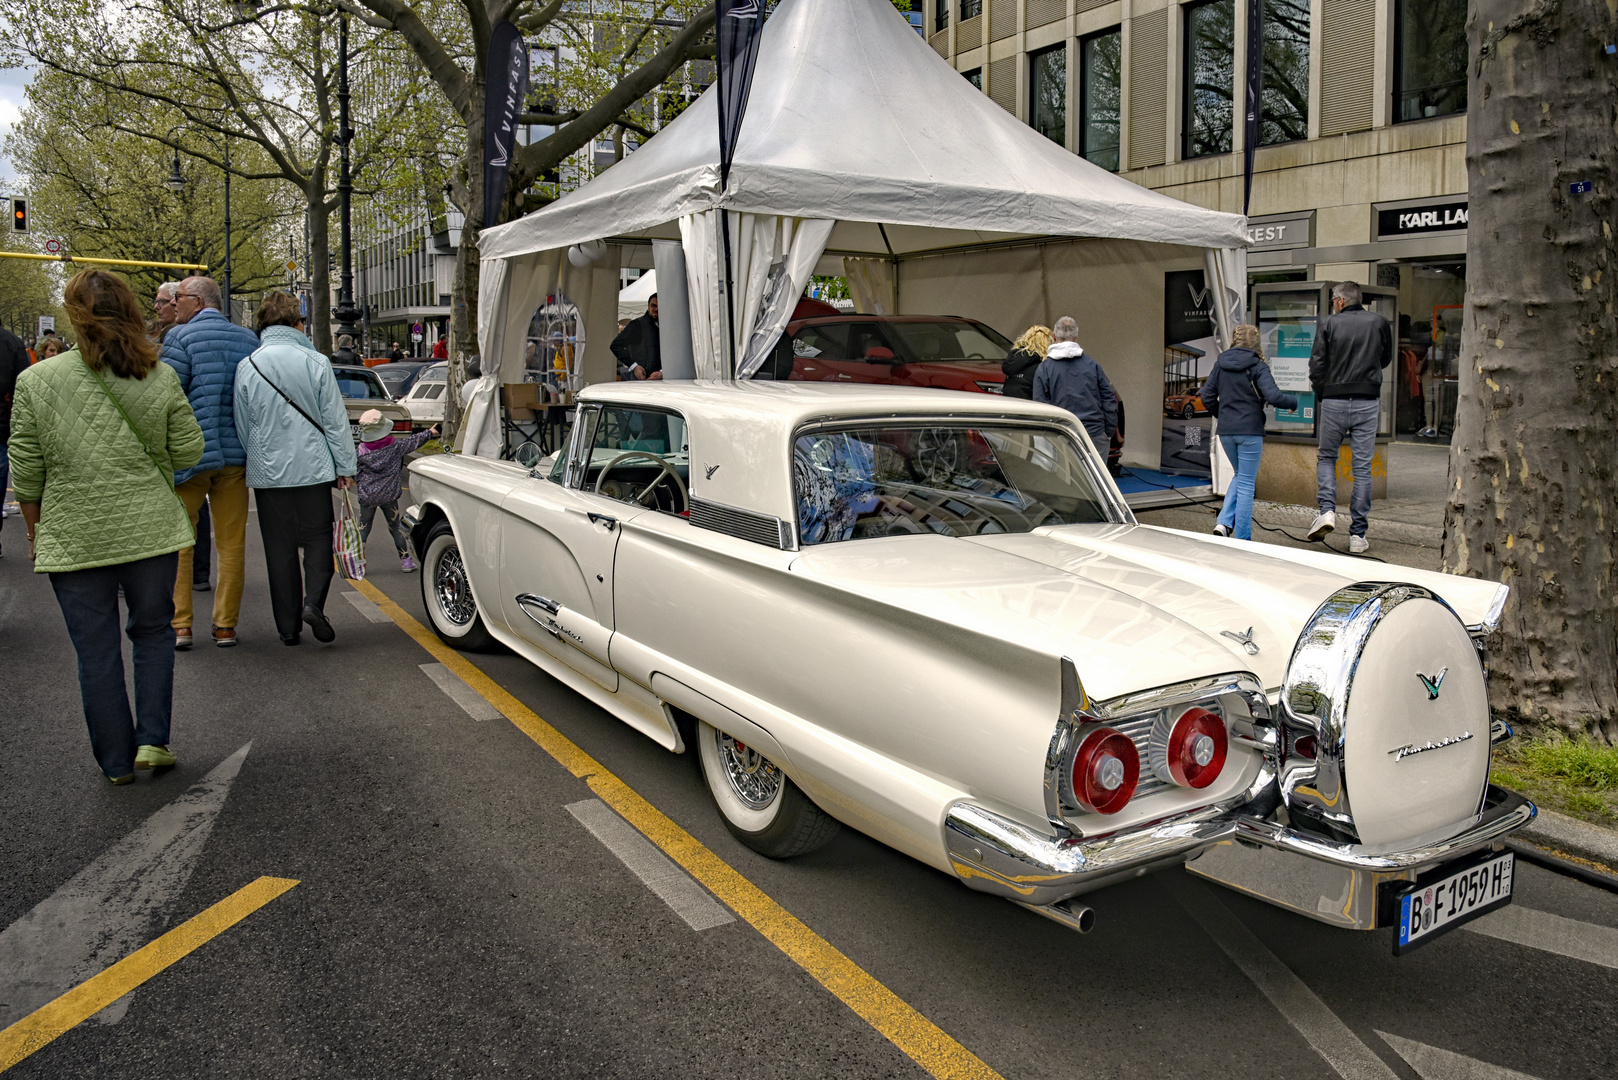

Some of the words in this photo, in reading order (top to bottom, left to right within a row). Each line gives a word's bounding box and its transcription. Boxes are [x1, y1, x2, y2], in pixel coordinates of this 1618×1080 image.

[501, 42, 524, 132] VINFAST
[1577, 185, 1585, 193] 51
[1399, 211, 1443, 229] KARL
